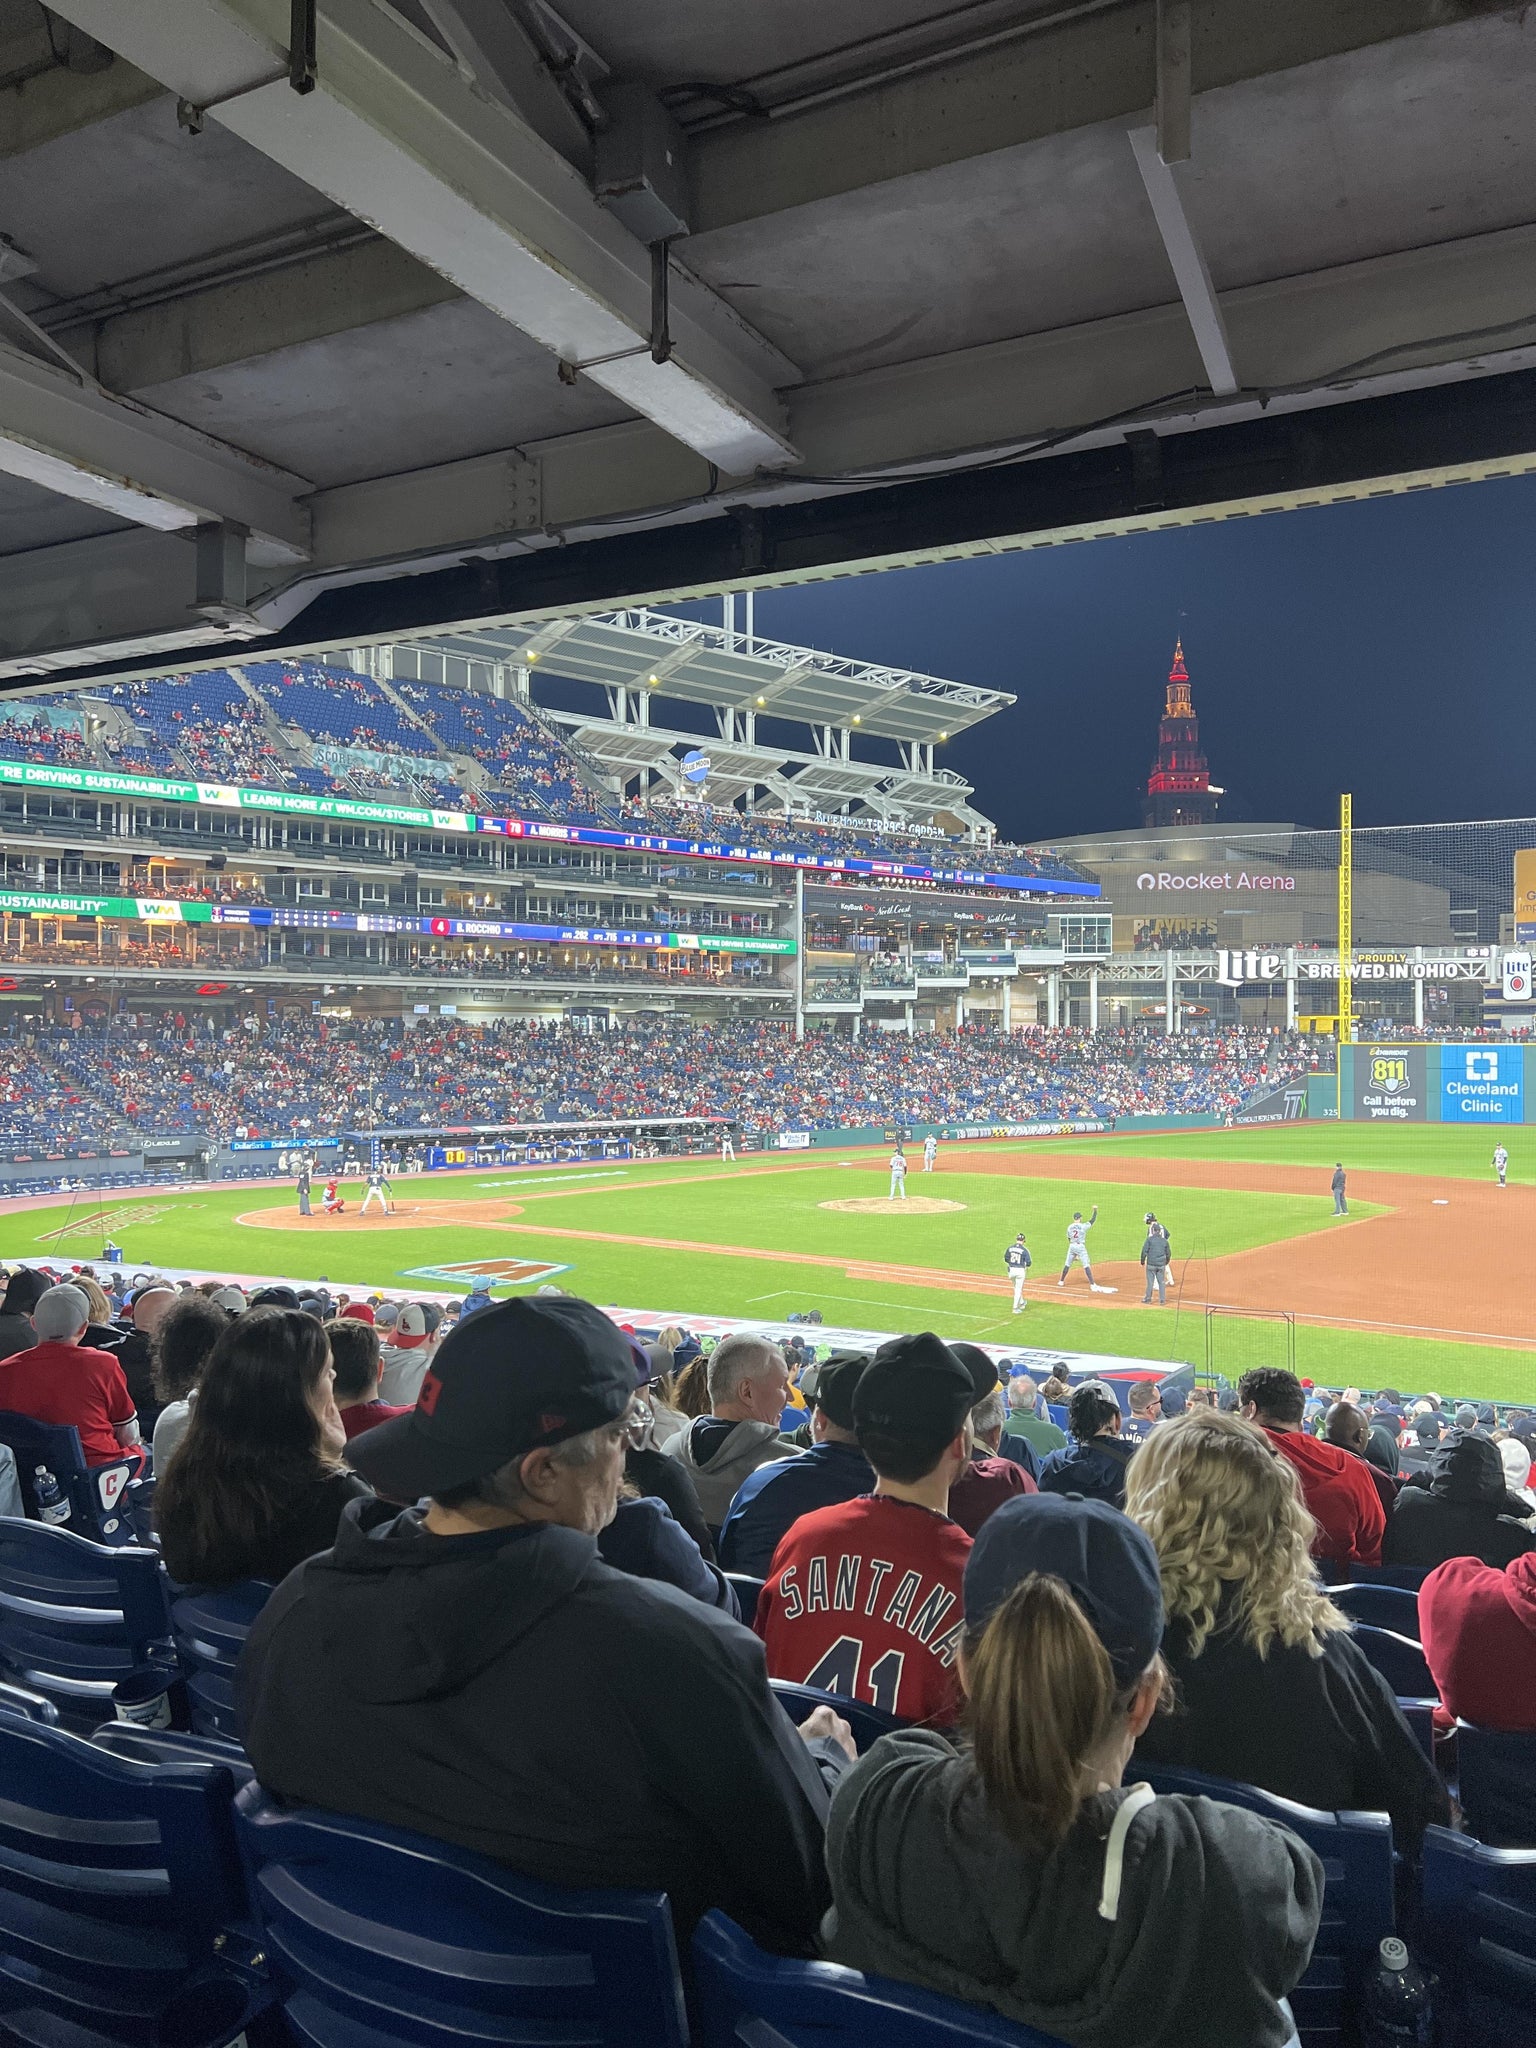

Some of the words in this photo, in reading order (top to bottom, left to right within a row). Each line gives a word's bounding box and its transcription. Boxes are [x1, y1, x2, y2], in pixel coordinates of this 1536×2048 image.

[26, 768, 82, 784] DRIVING
[243, 792, 282, 807] LEARN
[285, 796, 317, 810] MORE
[319, 801, 333, 812] AT
[335, 803, 430, 823] WM.COM/STORIES
[1158, 872, 1232, 890] Rocket
[1237, 872, 1295, 890] Arena
[0, 896, 101, 911] USTAINABILITY
[144, 904, 175, 915] WM
[840, 903, 864, 911] KeyBank
[954, 912, 974, 920] KeyBank
[436, 922, 444, 932] 4
[465, 923, 500, 935] ROCCHIO
[1134, 918, 1217, 935] PLAYOFFS
[1358, 953, 1406, 963] PROUDLY
[1216, 949, 1280, 987] Lite
[1308, 964, 1385, 979] BREWED
[1389, 963, 1408, 979] IN
[1414, 963, 1458, 978] OHIO
[1506, 961, 1529, 975] Lite
[1373, 1059, 1406, 1081] 811
[1446, 1082, 1519, 1095] Cleveland
[1363, 1096, 1382, 1106] Call
[1384, 1096, 1416, 1106] before
[1461, 1099, 1503, 1112] Clinic
[1323, 1108, 1338, 1116] 325
[1371, 1108, 1389, 1118] you
[1390, 1107, 1409, 1117] dig.
[234, 1142, 265, 1150] DollarBank
[1073, 1230, 1079, 1239] 2
[1010, 1252, 1021, 1264] 24
[106, 1474, 117, 1496] C
[779, 1554, 966, 1669] SANTANA
[803, 1635, 905, 1715] 41
